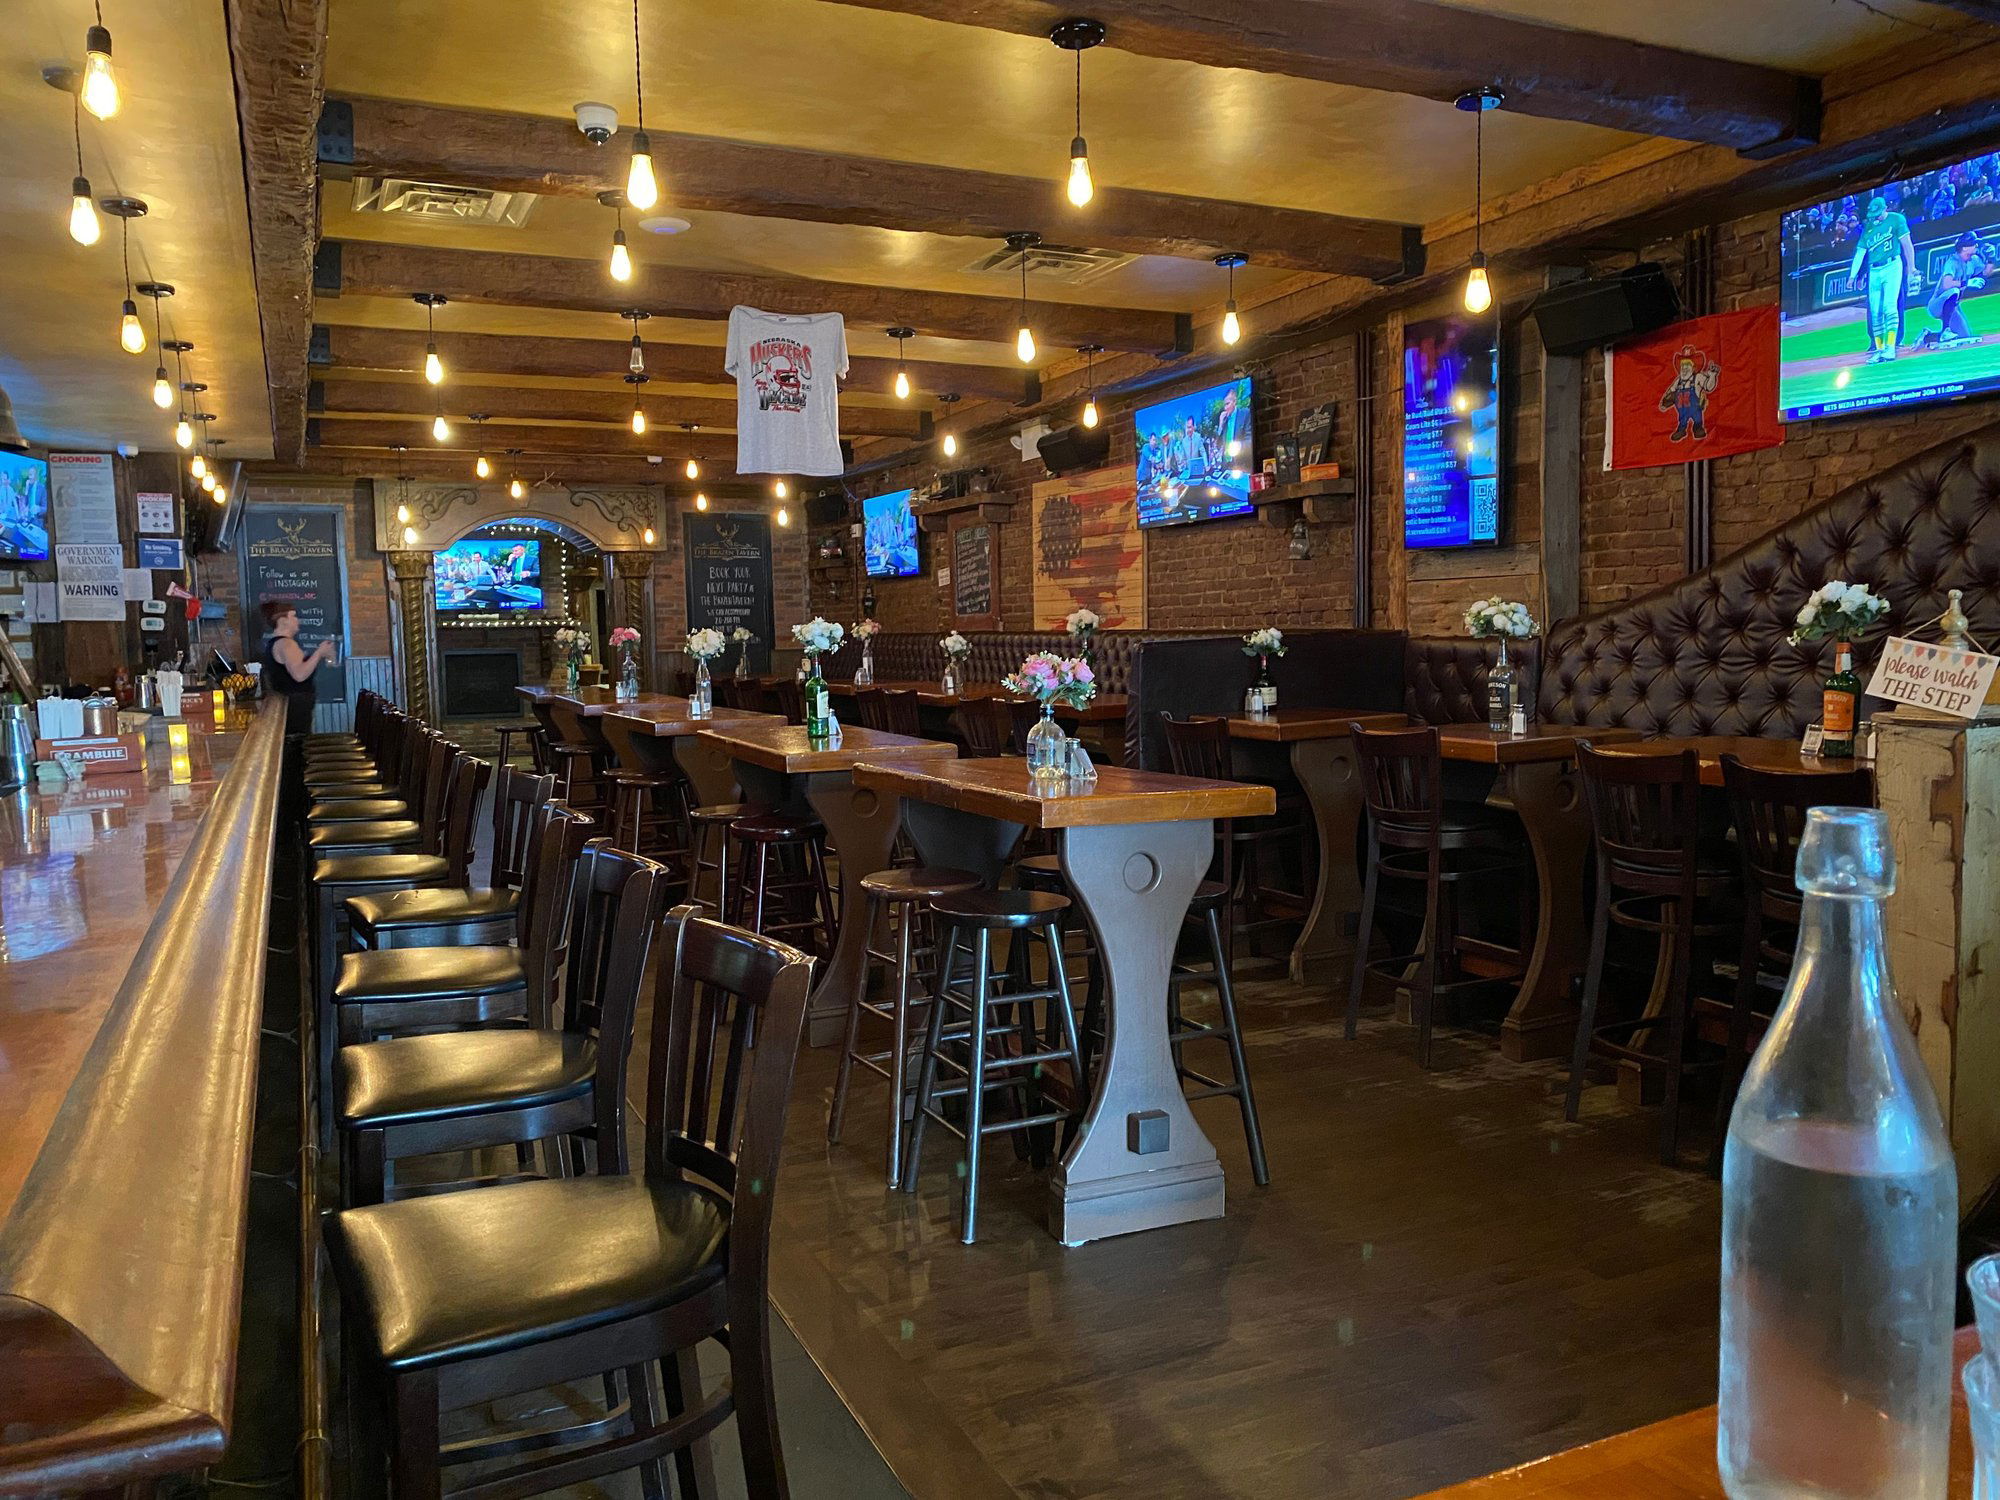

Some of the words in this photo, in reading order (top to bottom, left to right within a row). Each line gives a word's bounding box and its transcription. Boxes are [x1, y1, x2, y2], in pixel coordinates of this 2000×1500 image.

[1867, 226, 1892, 248] Oakland
[1884, 240, 1892, 251] 21
[763, 338, 801, 347] NEBRASKA
[750, 342, 812, 379] HUSKERS
[1892, 391, 1921, 401] September
[57, 547, 120, 556] GOVERNMENT
[303, 546, 333, 554] TAVERN
[67, 556, 113, 565] WARNING:
[260, 566, 283, 579] Follow
[274, 580, 318, 588] INSTAGRAM
[64, 585, 119, 596] WARNING
[1883, 656, 1931, 680] please
[1934, 668, 1980, 690] watch
[1881, 677, 1921, 701] THE
[1921, 687, 1971, 711] STEP
